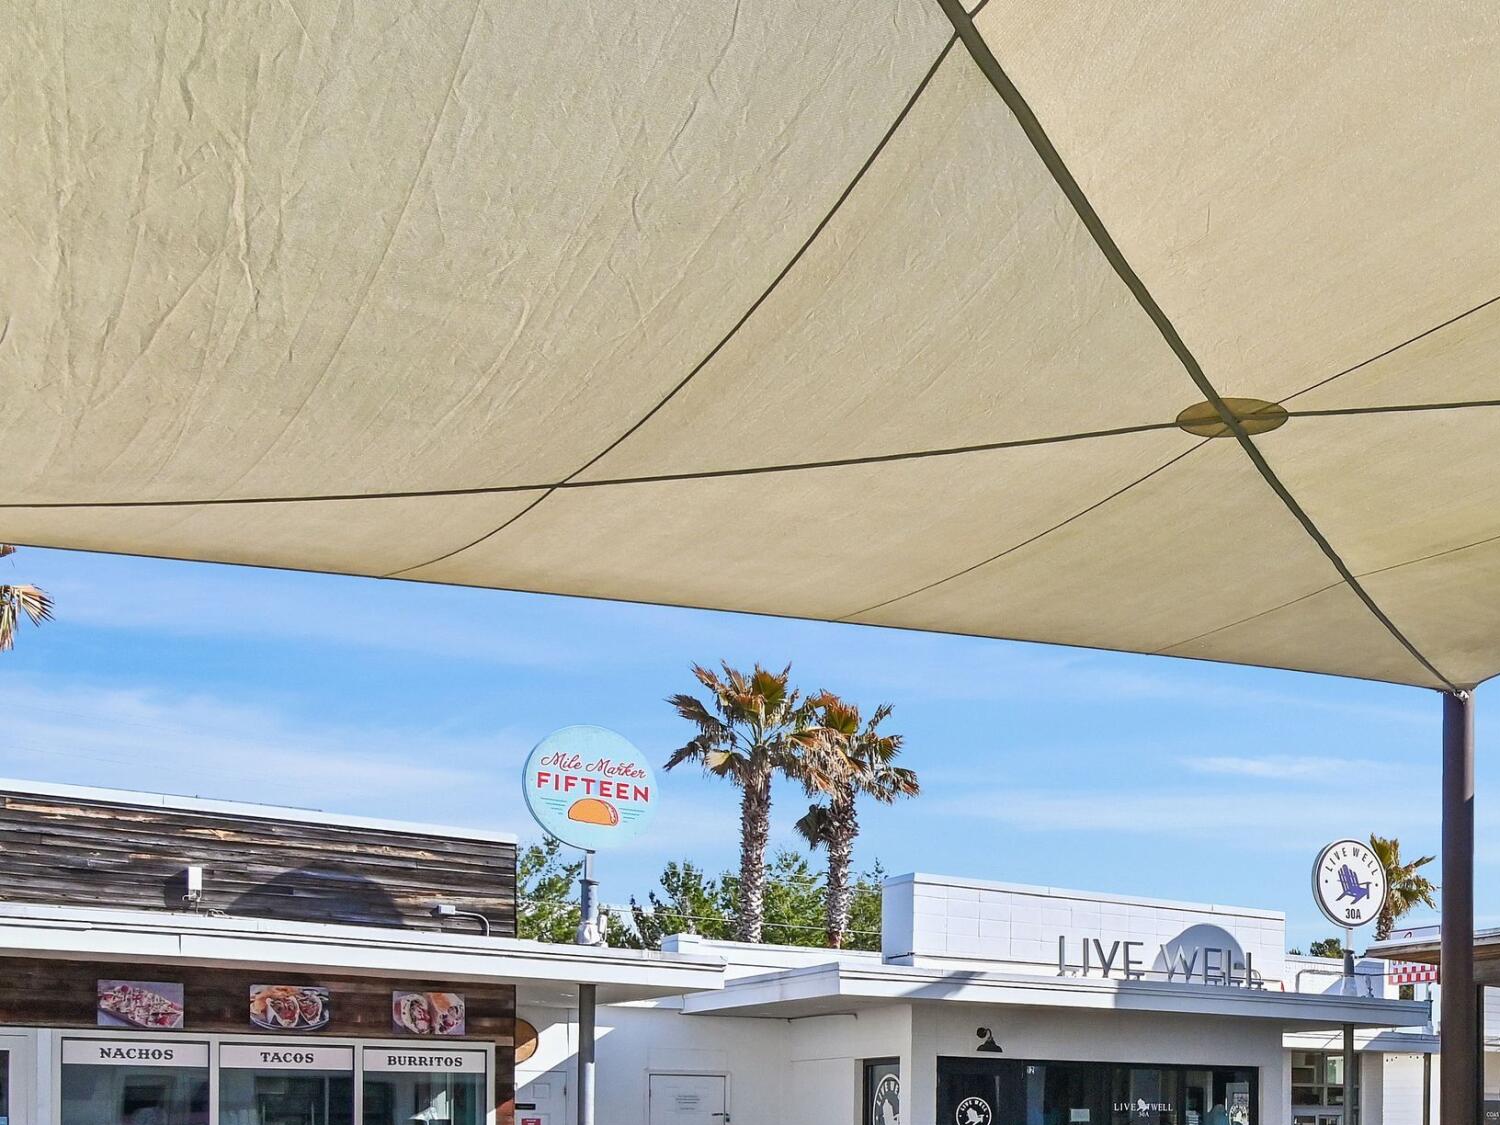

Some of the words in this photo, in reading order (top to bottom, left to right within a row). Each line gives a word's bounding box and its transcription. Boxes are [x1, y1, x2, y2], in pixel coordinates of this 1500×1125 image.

[541, 752, 582, 771] Mile
[585, 758, 646, 778] Marker
[537, 772, 649, 802] FIFTEEN
[1325, 847, 1347, 872] LIVE
[1353, 847, 1378, 875] WELL
[1345, 908, 1361, 919] 30A
[1058, 935, 1144, 977] LIVE
[1160, 944, 1264, 984] WELL
[100, 1047, 174, 1060] NACHOS
[260, 1052, 314, 1063] TACOS
[387, 1056, 462, 1067] BURRITOS
[960, 1100, 973, 1111] LIVE
[975, 1100, 987, 1112] WELL
[1114, 1103, 1136, 1111] LIVE
[1151, 1103, 1173, 1111] WELL
